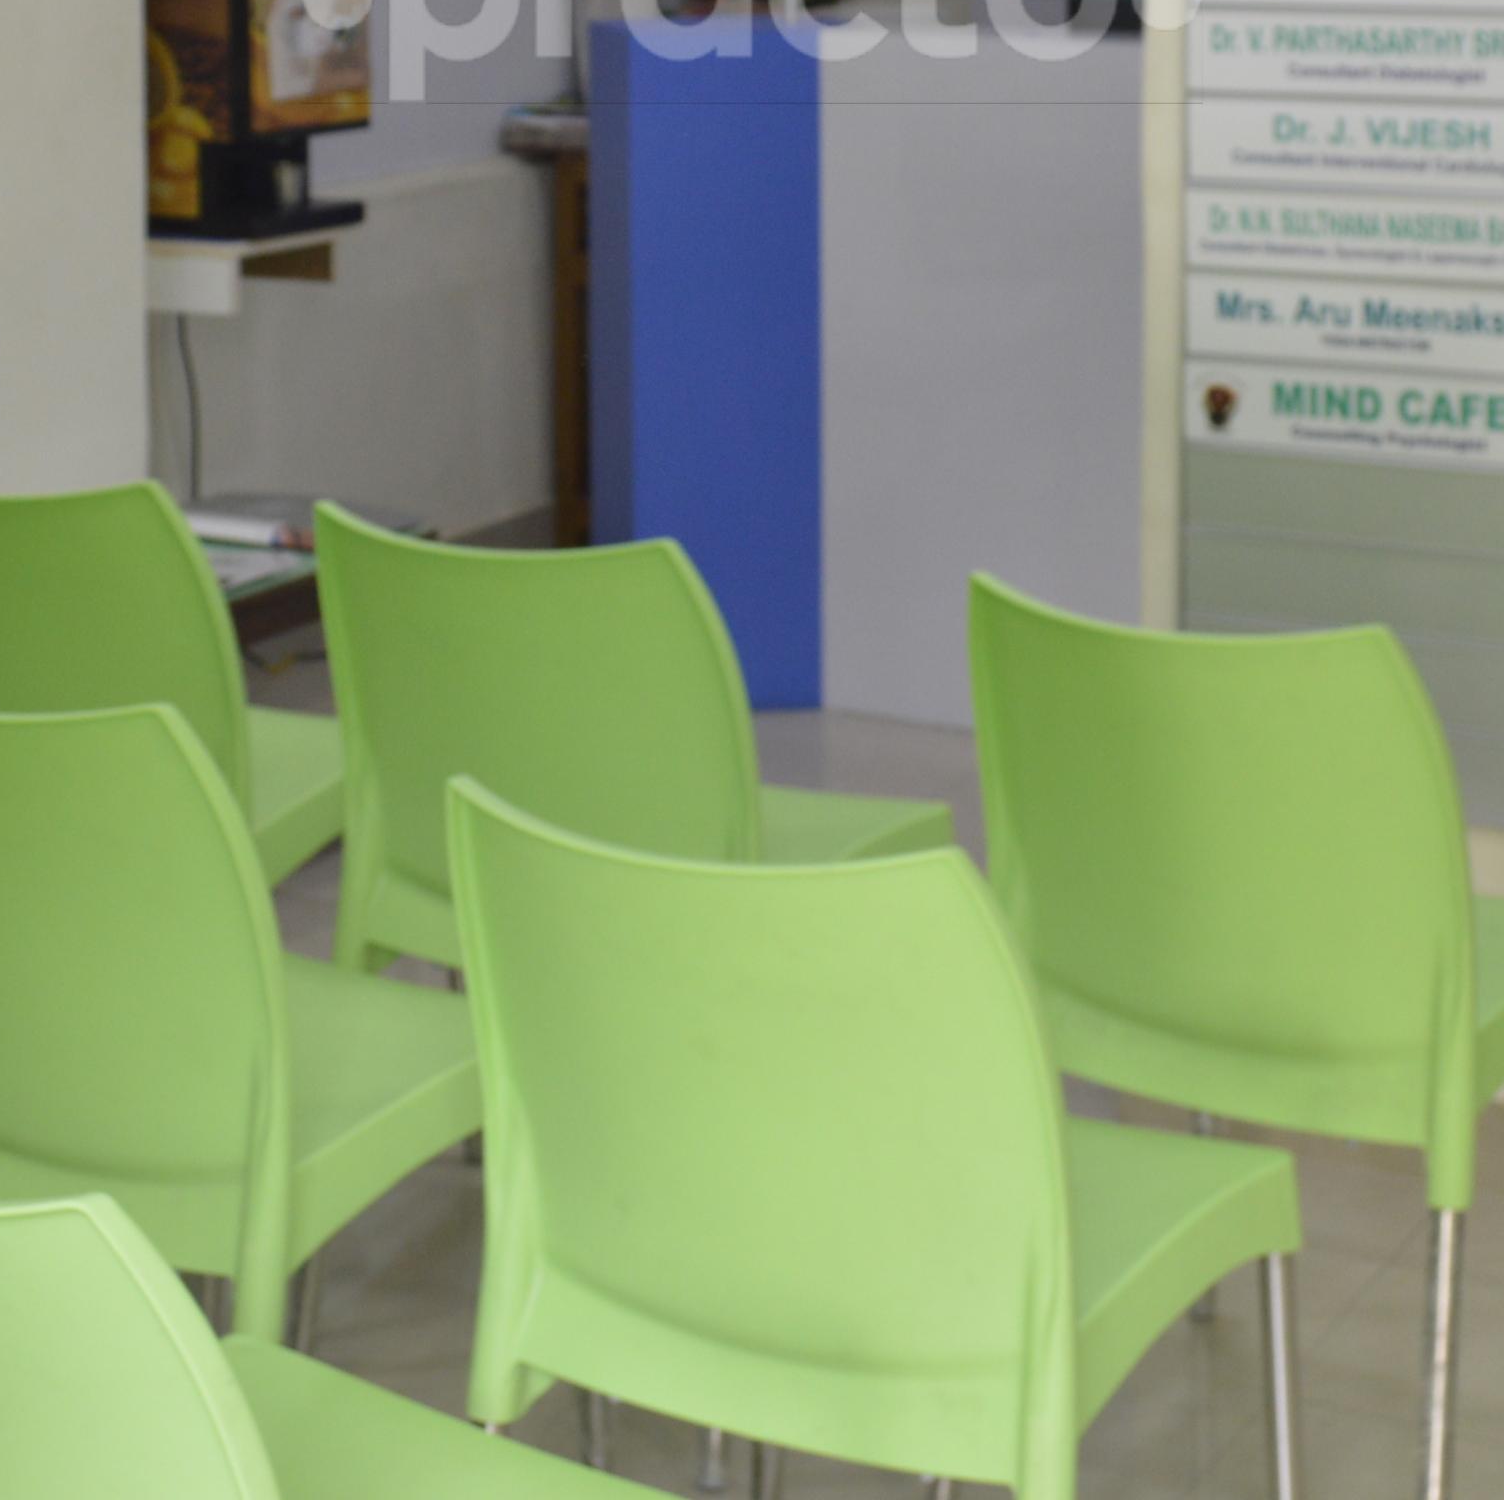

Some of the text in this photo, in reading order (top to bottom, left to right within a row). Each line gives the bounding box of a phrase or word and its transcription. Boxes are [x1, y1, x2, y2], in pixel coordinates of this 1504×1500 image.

[1273, 25, 1465, 56] PARTHASARTHY
[1272, 113, 1316, 144] Dr.
[1365, 118, 1492, 149] VIJESH
[1216, 290, 1283, 323] Mrs.
[1294, 296, 1351, 327] Aru
[1273, 381, 1382, 422] MIND
